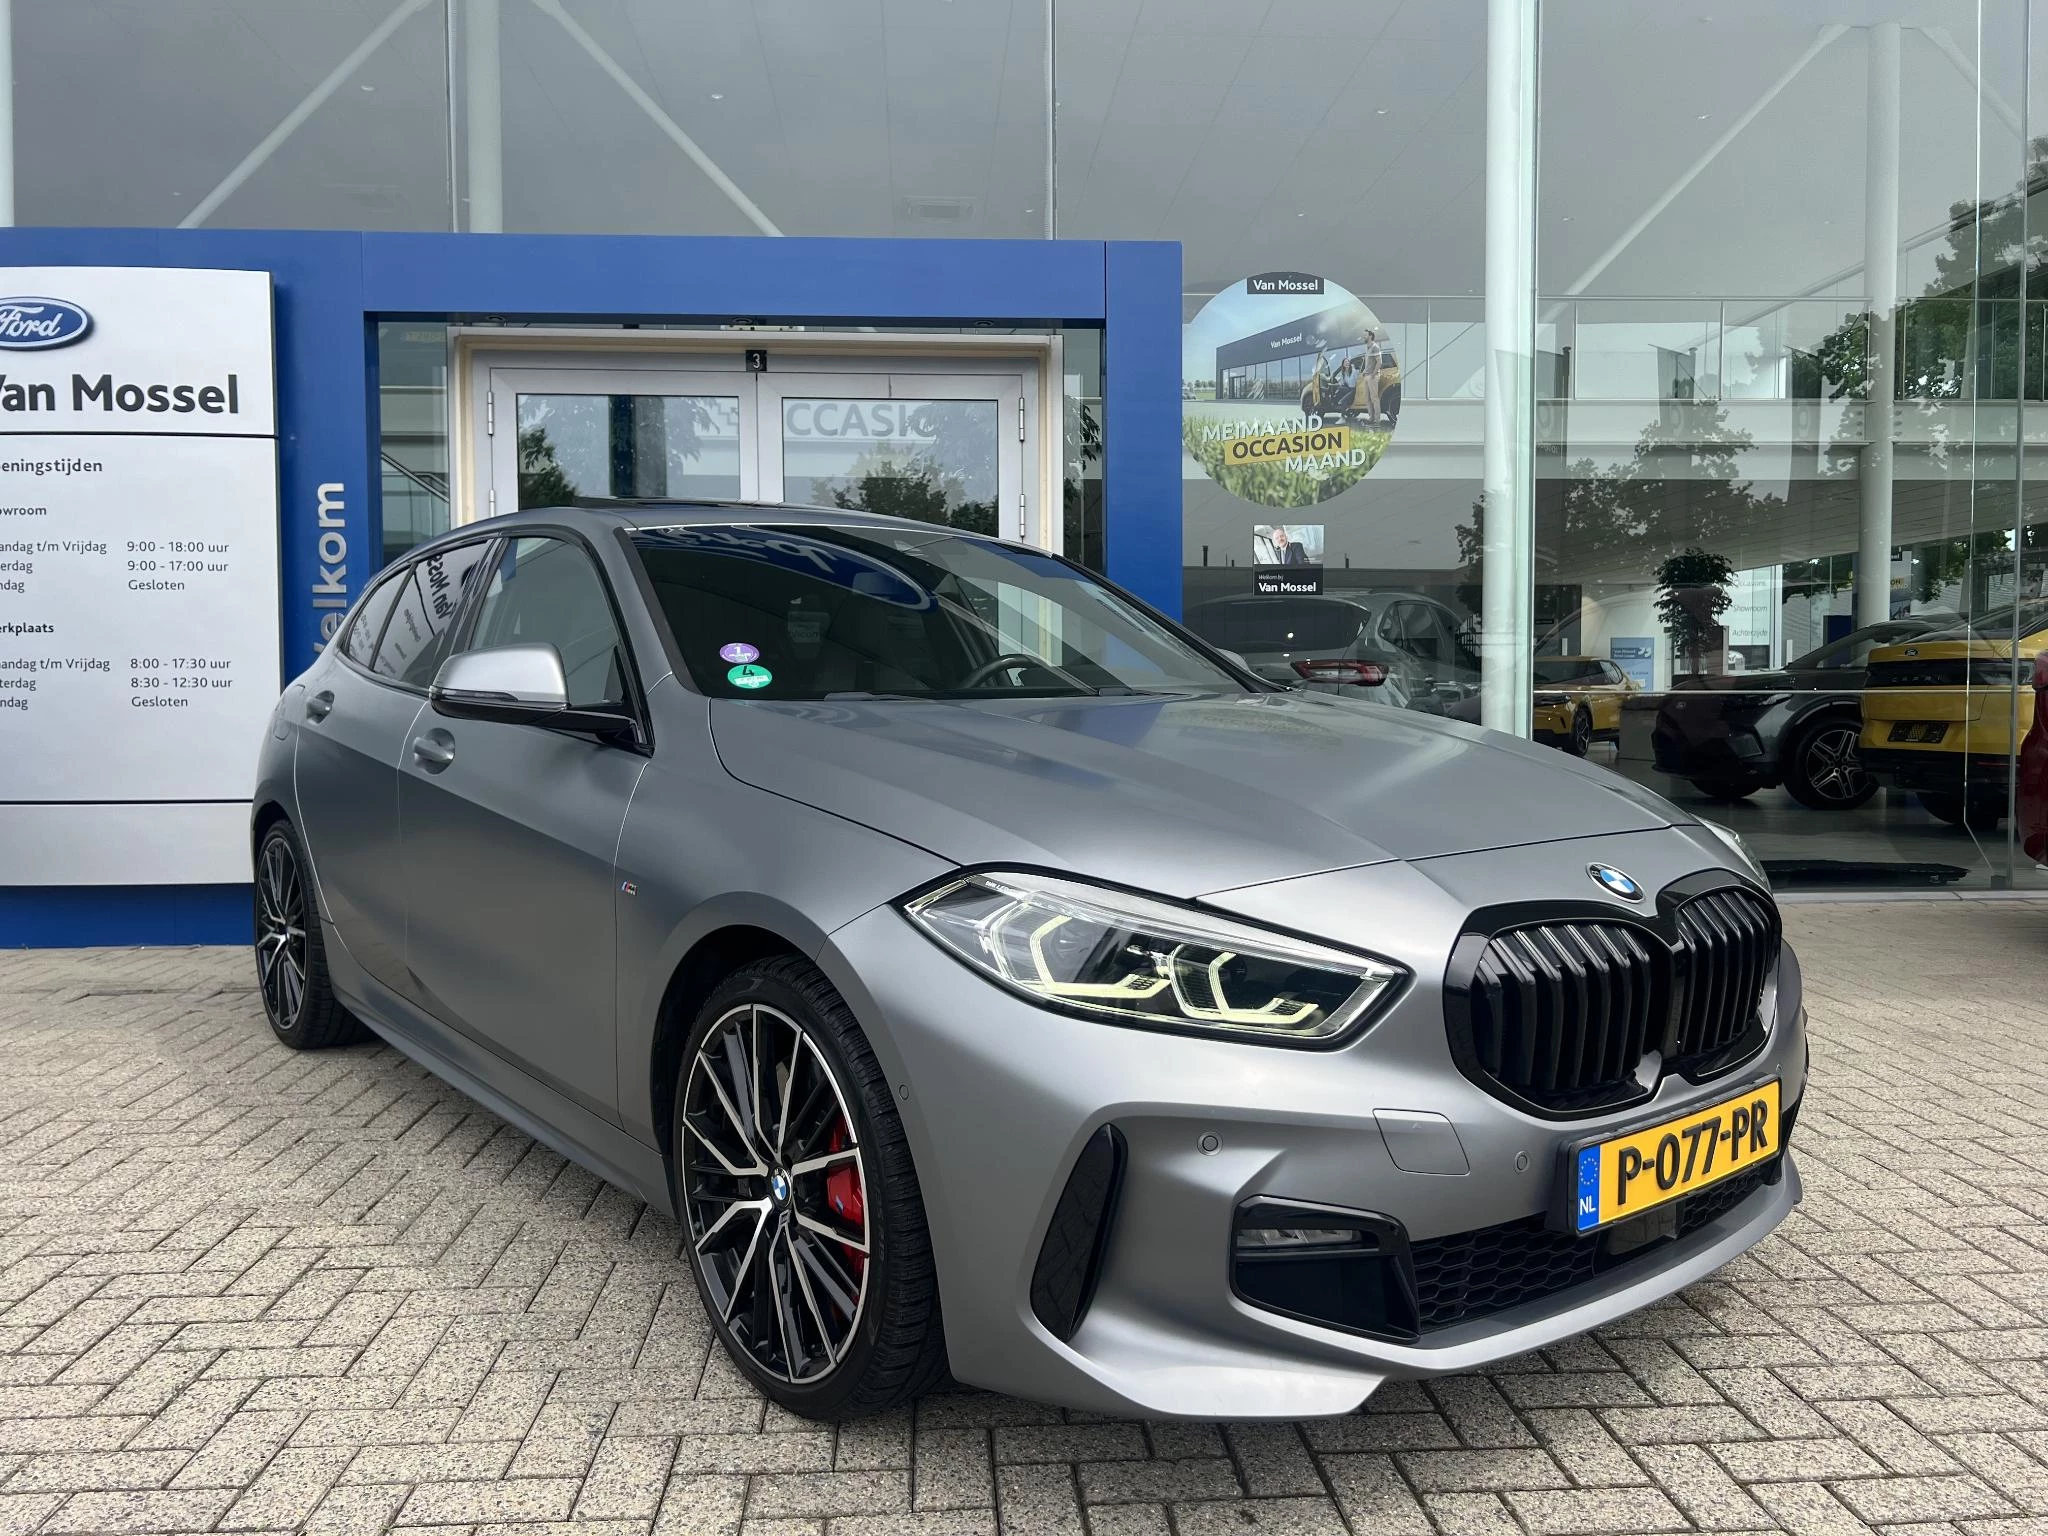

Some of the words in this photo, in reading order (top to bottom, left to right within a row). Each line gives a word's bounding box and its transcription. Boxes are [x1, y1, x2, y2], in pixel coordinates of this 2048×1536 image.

[1253, 279, 1275, 291] Van
[1278, 279, 1318, 291] Mossel
[753, 353, 761, 369] 3
[72, 374, 239, 414] Mossel
[1232, 431, 1342, 459] OCCASION
[1285, 448, 1366, 474] MAAND
[36, 541, 59, 552] t/m
[62, 541, 107, 555] Vrijdag
[127, 541, 156, 552] 9:00
[168, 541, 204, 552] 18:00
[208, 544, 230, 553] uur
[127, 560, 156, 571] 9:00
[168, 560, 204, 571] 17:00
[207, 563, 229, 572] uur
[312, 483, 347, 653] elkom
[128, 579, 185, 590] Gesloten
[1258, 582, 1278, 592] Van
[1280, 581, 1317, 592] Mossel
[40, 658, 62, 669] t/m
[65, 658, 111, 672] Vrijdag
[130, 658, 160, 669] 8:00
[172, 658, 206, 669] 17:30
[210, 660, 232, 669] uur
[742, 665, 755, 676] 4
[130, 677, 160, 688] 8:30
[172, 677, 208, 688] 12:30
[211, 680, 233, 688] uur
[131, 696, 188, 707] Gesloten
[1617, 1099, 1768, 1206] P-077-PR
[1579, 1196, 1596, 1216] NL
